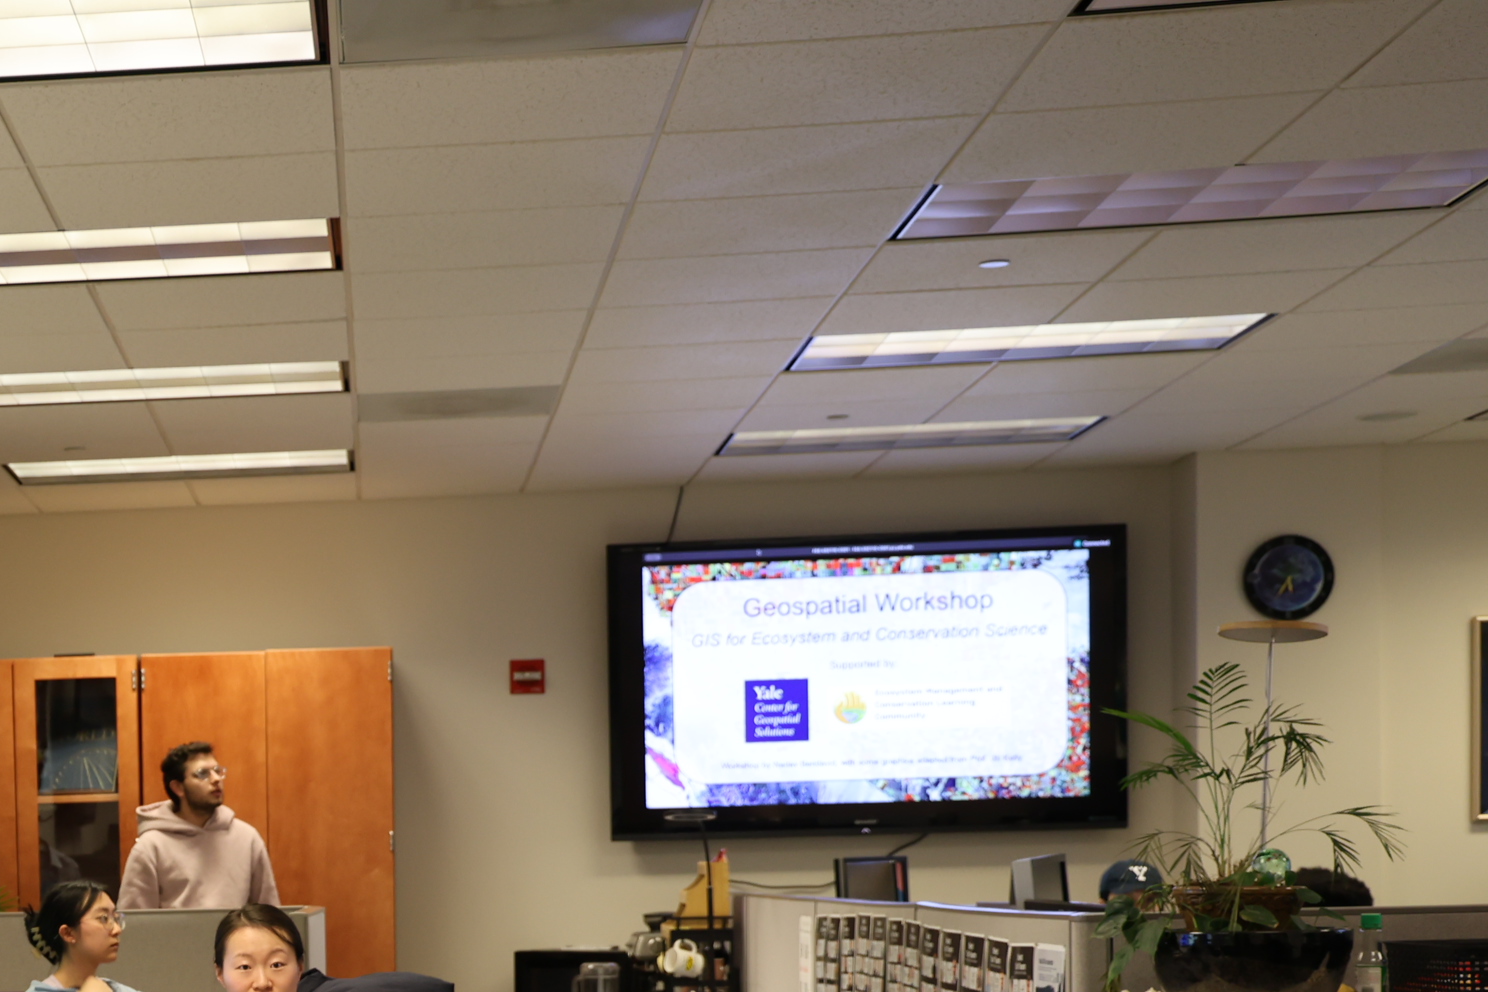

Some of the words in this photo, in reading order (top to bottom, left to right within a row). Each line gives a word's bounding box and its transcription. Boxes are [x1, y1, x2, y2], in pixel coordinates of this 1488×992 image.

[742, 593, 867, 619] Geospatial
[875, 591, 994, 614] Workshop
[691, 632, 721, 648] GIS
[726, 631, 746, 646] for
[751, 630, 836, 649] Ecosystem
[841, 627, 870, 642] and
[876, 623, 980, 642] Conservation
[985, 621, 1048, 637] Science
[752, 684, 784, 701] Yale
[754, 701, 784, 714] Center
[782, 700, 800, 715] for
[753, 712, 802, 727] Geospatial
[754, 725, 796, 738] Solutions
